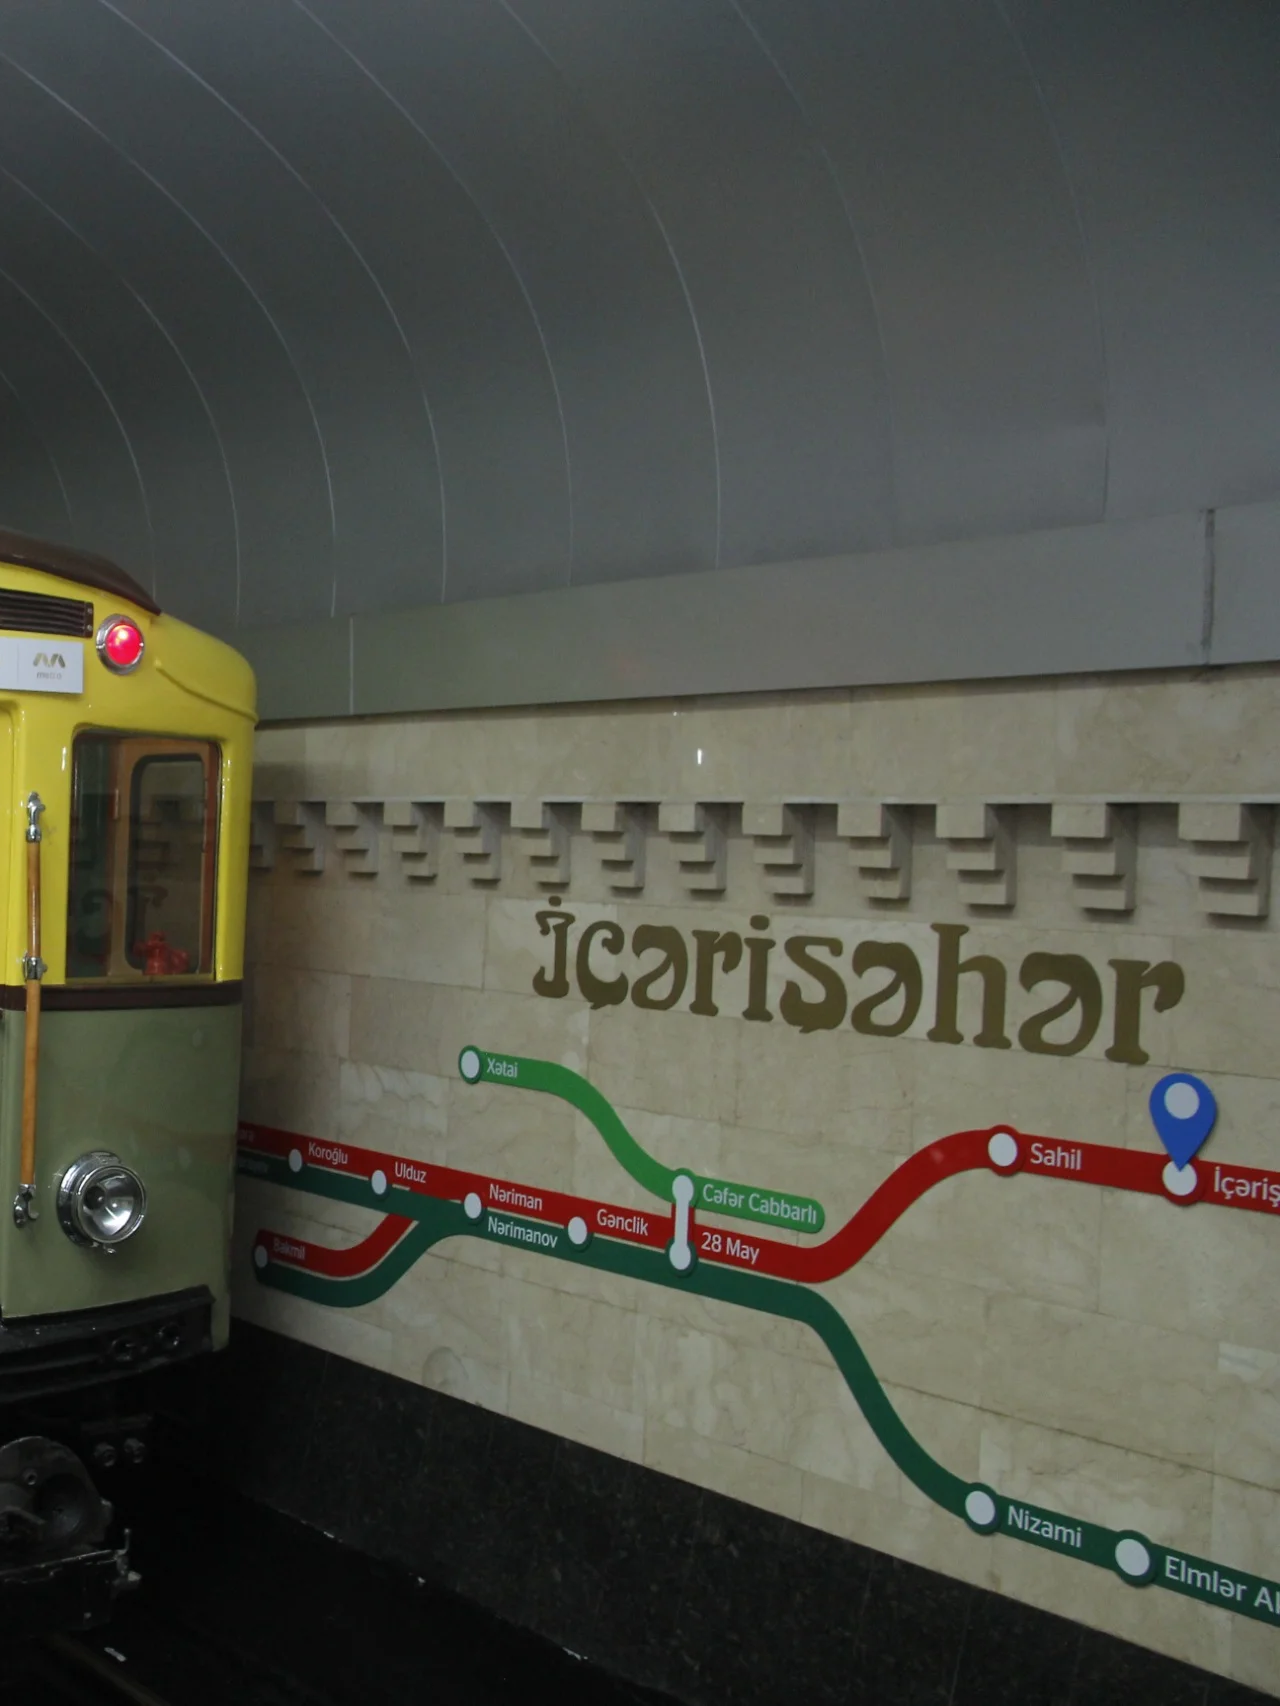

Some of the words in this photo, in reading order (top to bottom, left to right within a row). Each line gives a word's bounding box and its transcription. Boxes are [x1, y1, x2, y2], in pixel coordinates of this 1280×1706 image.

[532, 895, 1186, 1065] İçərişəhər
[486, 1058, 518, 1079] Xətai
[307, 1141, 349, 1166] Koroğlu
[1030, 1142, 1082, 1171] Sahil
[394, 1161, 427, 1184] Ulduz
[489, 1183, 543, 1212] Nəriman
[702, 1183, 746, 1209] Cəfər
[748, 1193, 817, 1224] Cabbarlı
[488, 1216, 559, 1249] Nərimanov
[596, 1208, 649, 1237] Gənclik
[701, 1231, 721, 1253] 28
[726, 1238, 760, 1265] May
[1007, 1505, 1083, 1548] Nizami
[1165, 1555, 1248, 1601] Elmlər
